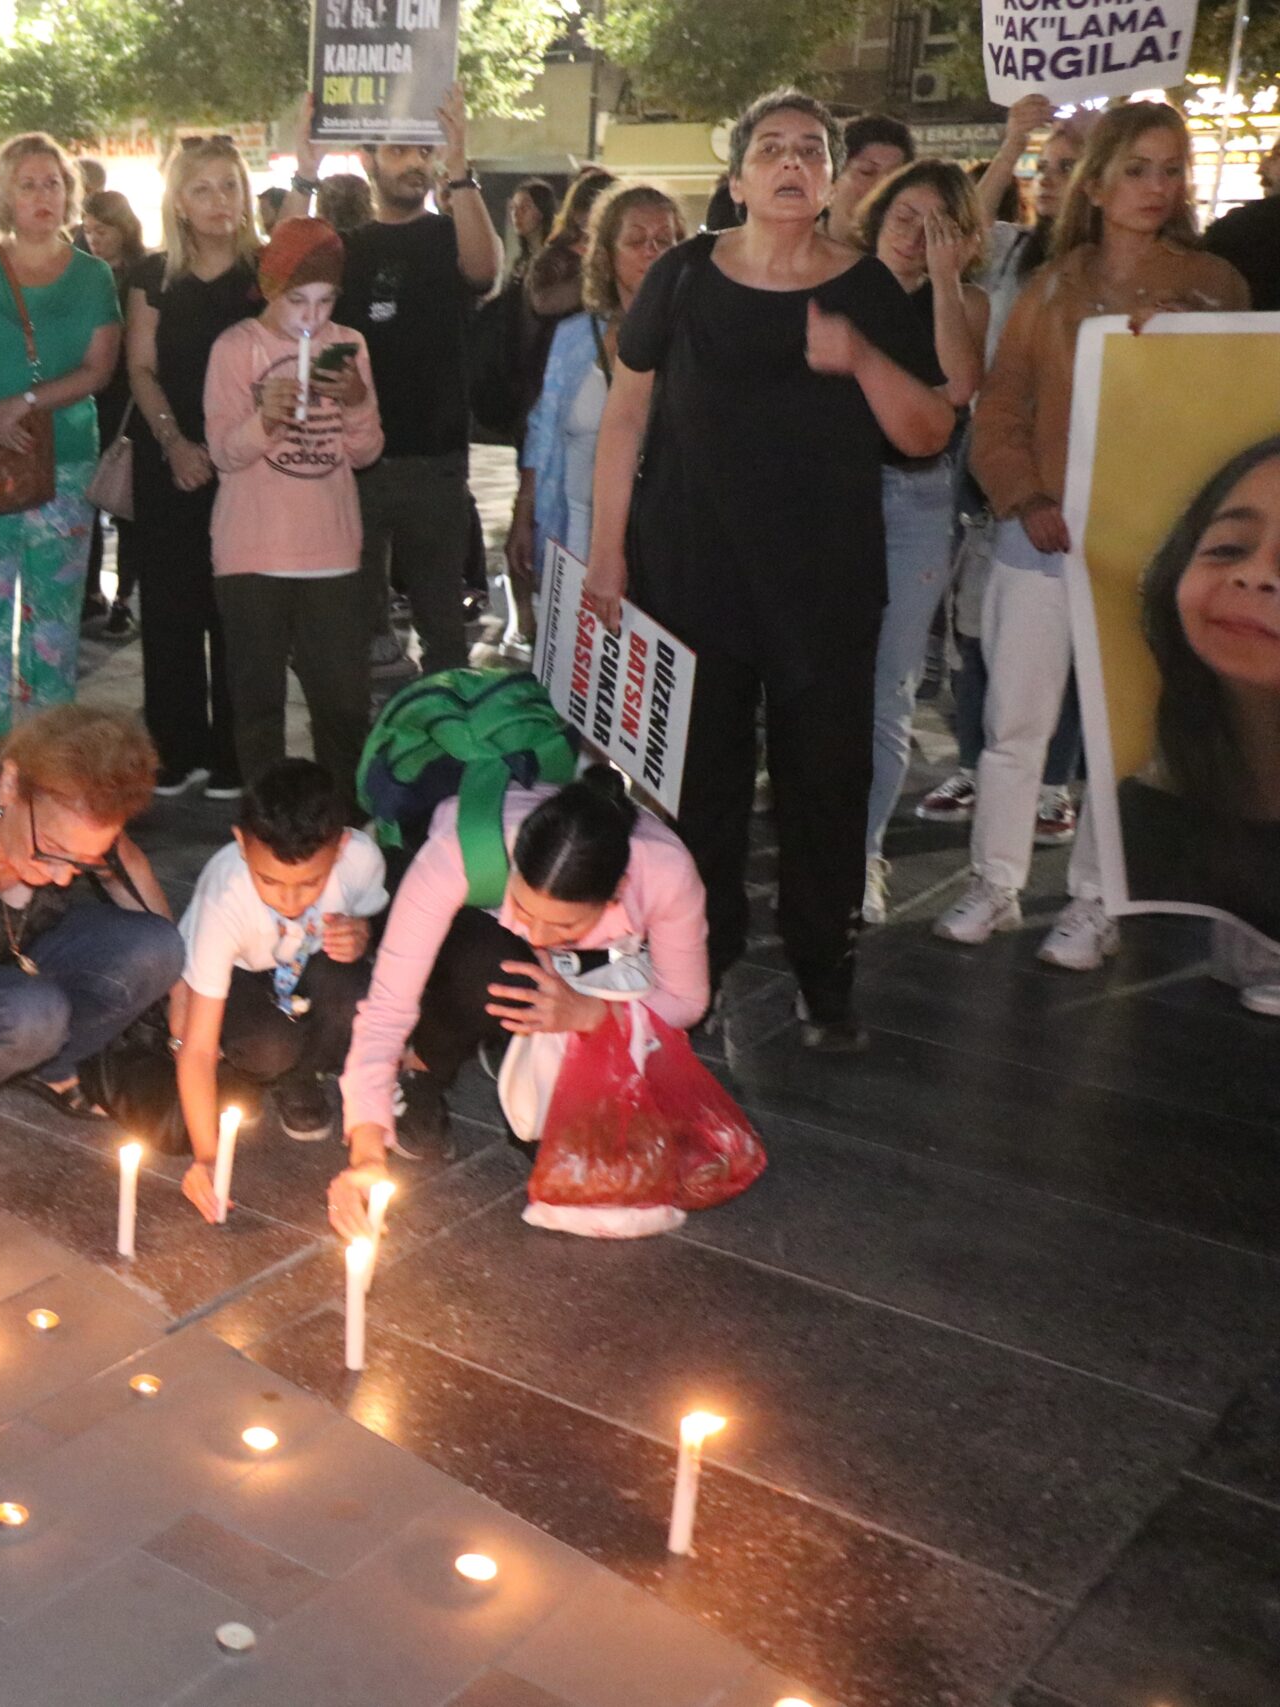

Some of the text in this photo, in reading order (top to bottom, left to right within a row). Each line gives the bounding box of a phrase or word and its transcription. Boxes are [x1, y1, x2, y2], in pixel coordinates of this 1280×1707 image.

[277, 448, 337, 466] adidas
[568, 582, 596, 727] AŞASIN!!!
[592, 604, 623, 748] CUKLAR
[620, 630, 648, 740] BATSIN
[643, 638, 676, 791] DÜZENİNİZ
